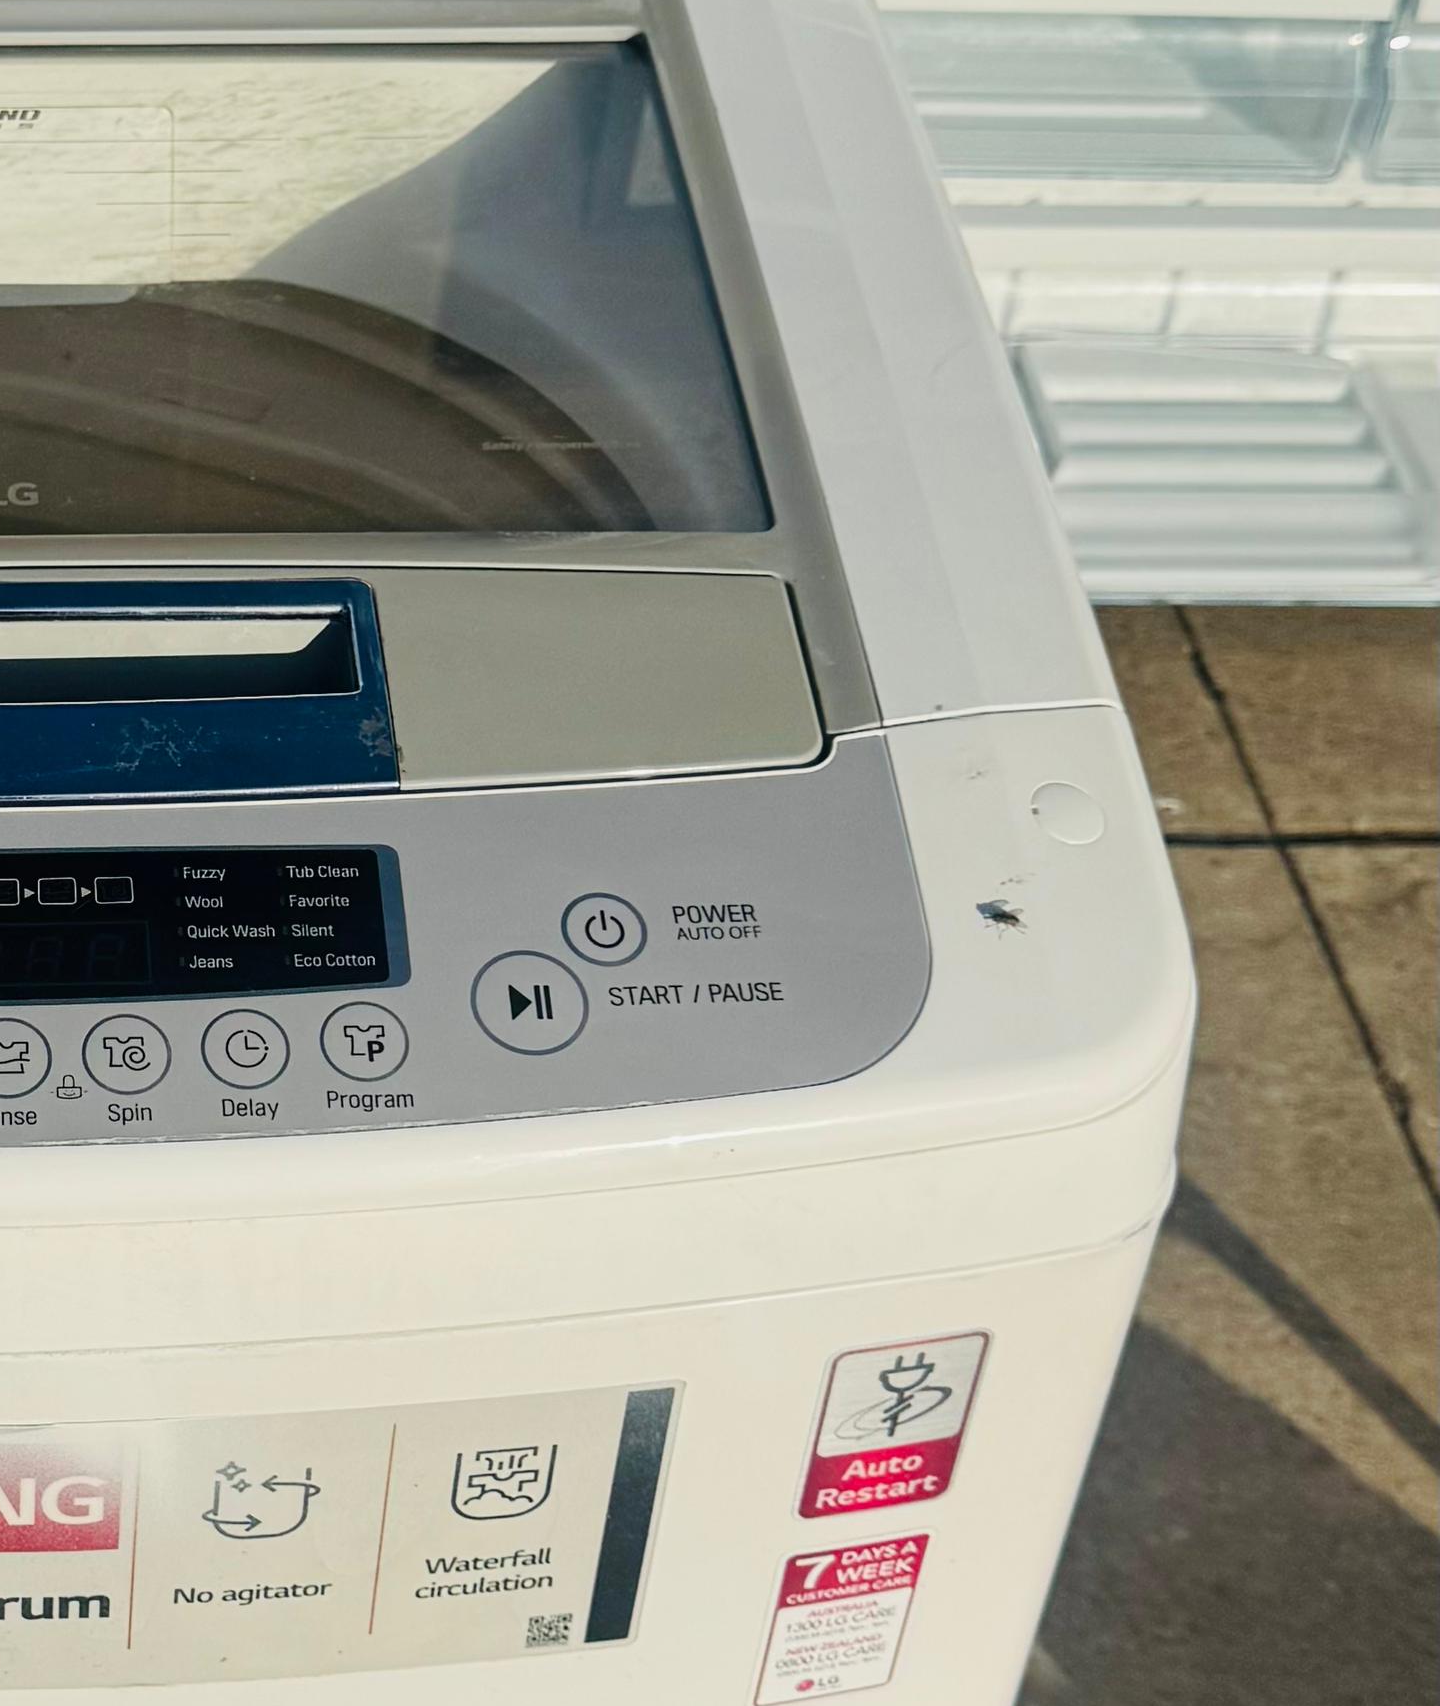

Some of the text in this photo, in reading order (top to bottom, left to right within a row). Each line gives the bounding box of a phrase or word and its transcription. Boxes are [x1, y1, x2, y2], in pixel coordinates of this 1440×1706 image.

[182, 866, 226, 881] Fuzzy
[285, 865, 360, 879] Tub Clean
[184, 895, 224, 909] Wool
[288, 894, 351, 908] Favorite
[672, 903, 757, 925] POWER
[186, 924, 276, 940] Quick Wash
[291, 924, 335, 937] Silent
[676, 925, 763, 942] AUTO OFF
[189, 955, 234, 969] Jeans
[294, 952, 377, 968] Eco Cotton
[608, 984, 684, 1007] START
[707, 981, 785, 1004] PAUSE
[220, 1097, 280, 1120] Delay
[326, 1089, 416, 1114] Program
[107, 1103, 154, 1128] Spin
[840, 1453, 924, 1482] Auto
[814, 1474, 940, 1510] Restart
[424, 1547, 552, 1576] Waterfall
[840, 1539, 920, 1565] DAYS A
[795, 1553, 836, 1591] 7
[836, 1556, 916, 1584] WEEK
[172, 1578, 334, 1607] No agitator
[414, 1573, 554, 1601] circulation
[785, 1582, 871, 1606] CUSTOMER
